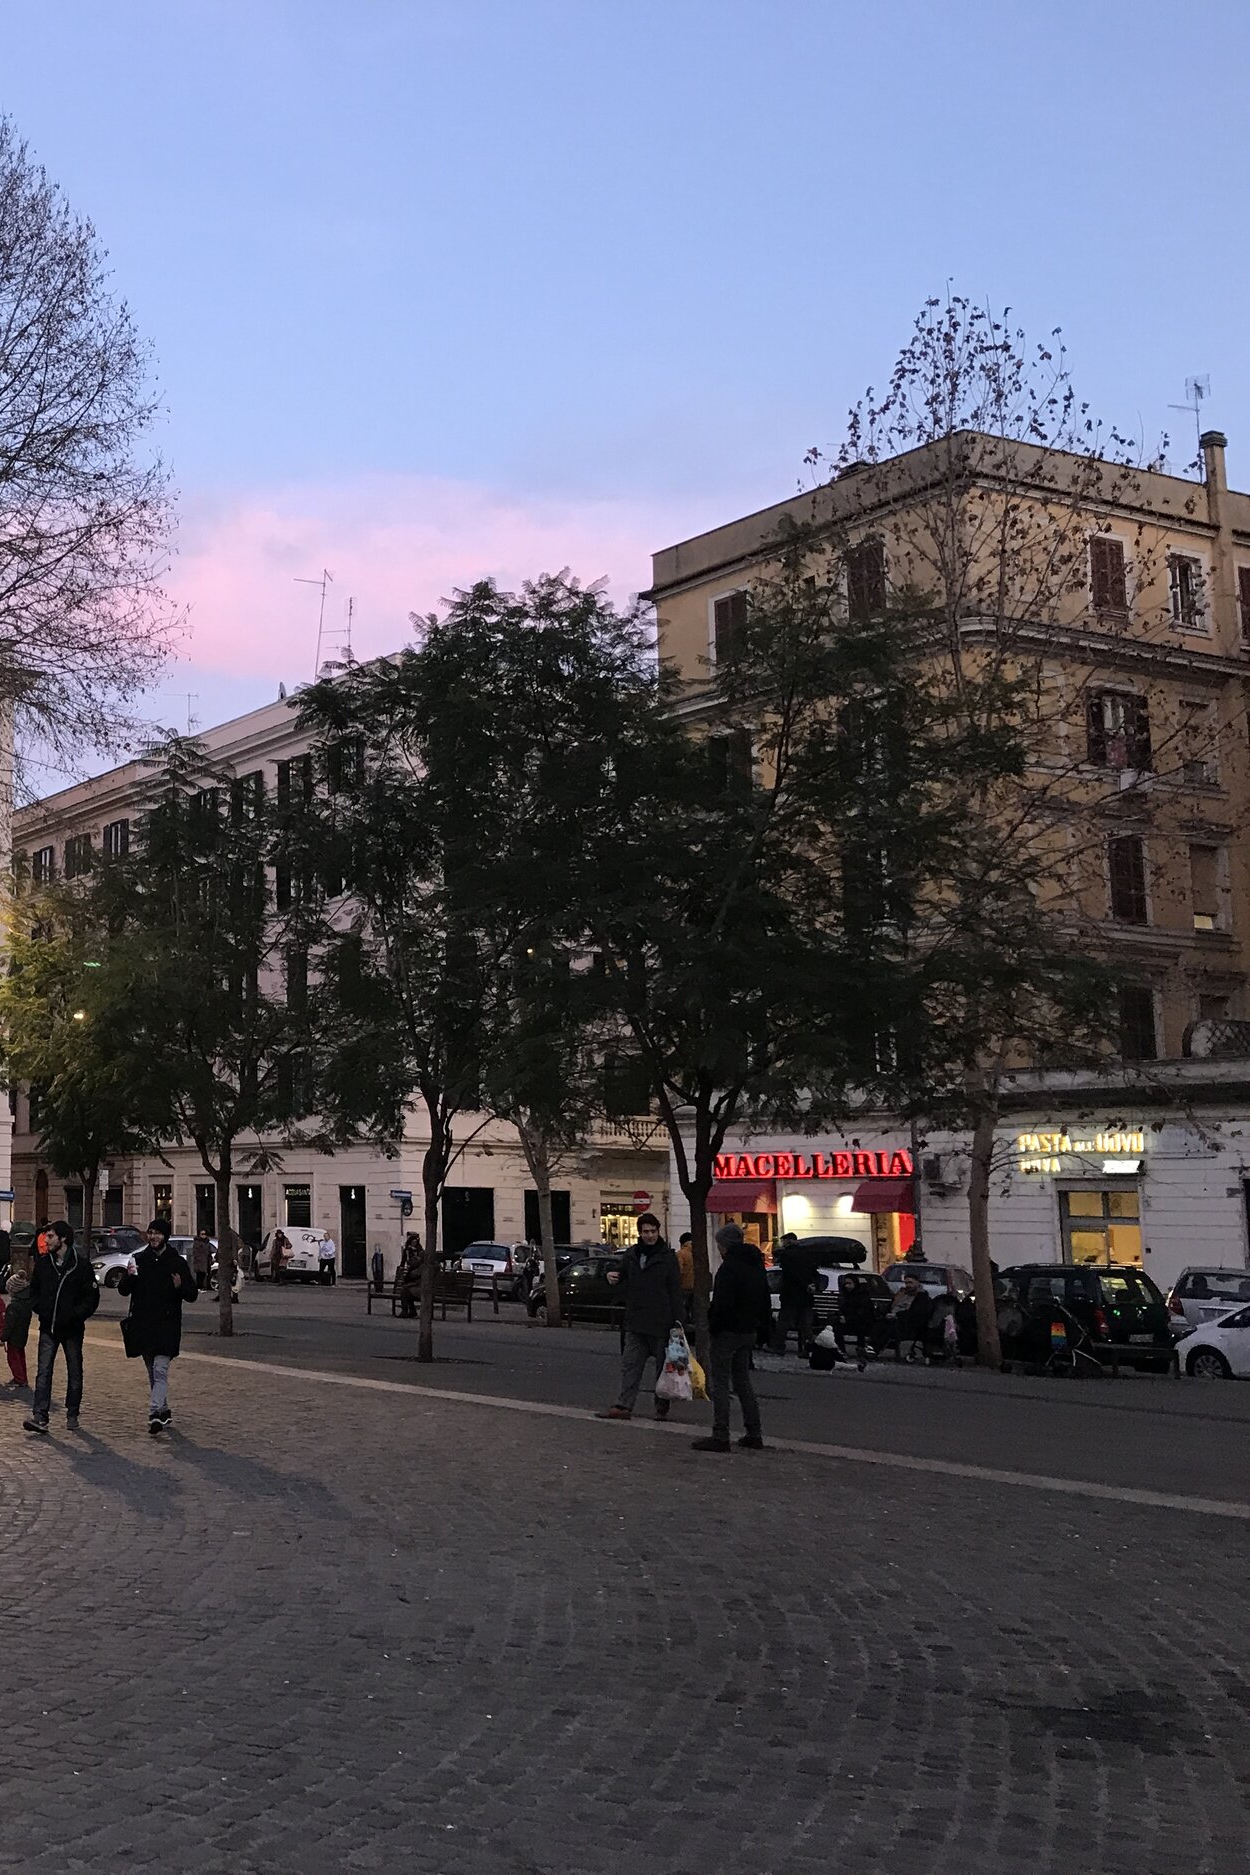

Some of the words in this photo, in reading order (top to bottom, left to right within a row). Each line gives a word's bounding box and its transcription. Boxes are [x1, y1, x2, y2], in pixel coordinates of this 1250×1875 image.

[1018, 1132, 1071, 1152] PASTA
[1096, 1132, 1144, 1152] UOVO
[713, 1150, 914, 1178] MACELLERIA
